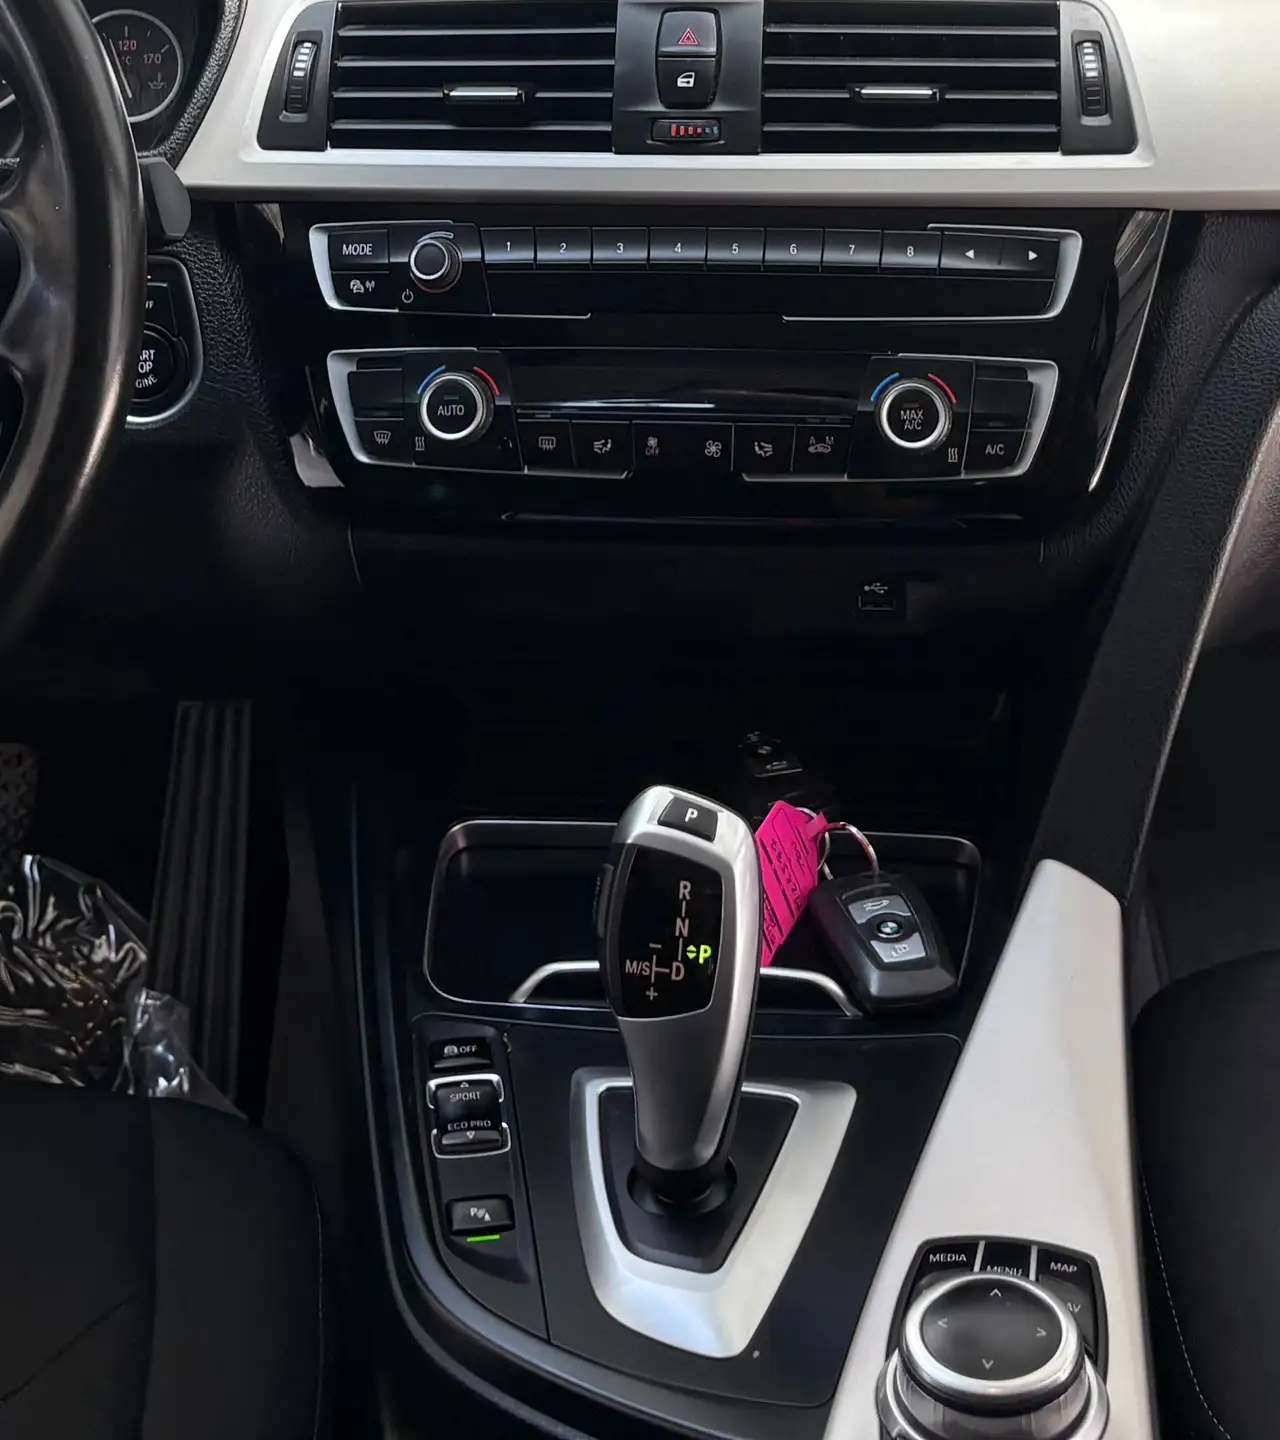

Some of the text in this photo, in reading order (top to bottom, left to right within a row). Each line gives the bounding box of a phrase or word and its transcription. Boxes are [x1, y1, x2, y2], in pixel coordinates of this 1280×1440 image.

[118, 40, 137, 51] 120
[143, 53, 162, 64] 170
[342, 244, 372, 256] MODE
[506, 241, 512, 252] 1
[559, 242, 567, 253] 2
[616, 242, 624, 253] 3
[674, 243, 682, 254] 4
[732, 244, 739, 254] 5
[789, 244, 797, 255] 6
[849, 245, 856, 256] 7
[906, 246, 914, 257] 8
[437, 404, 465, 417] AUTO
[900, 409, 924, 421] MAX
[904, 419, 922, 431] A/C
[825, 436, 835, 445] M
[645, 446, 660, 457] OFF
[985, 444, 1004, 456] A/C
[684, 808, 698, 822] P
[678, 880, 692, 900] R
[675, 917, 689, 937] N
[698, 944, 712, 964] P
[625, 959, 651, 975] M/S
[671, 961, 685, 981] D
[459, 1045, 477, 1053] OFF
[449, 1092, 481, 1102] SPORT
[447, 1120, 492, 1131] ECO PRO
[929, 1252, 967, 1263] MEDIA
[986, 1264, 1023, 1276] MENU
[1050, 1262, 1078, 1273] MAP
